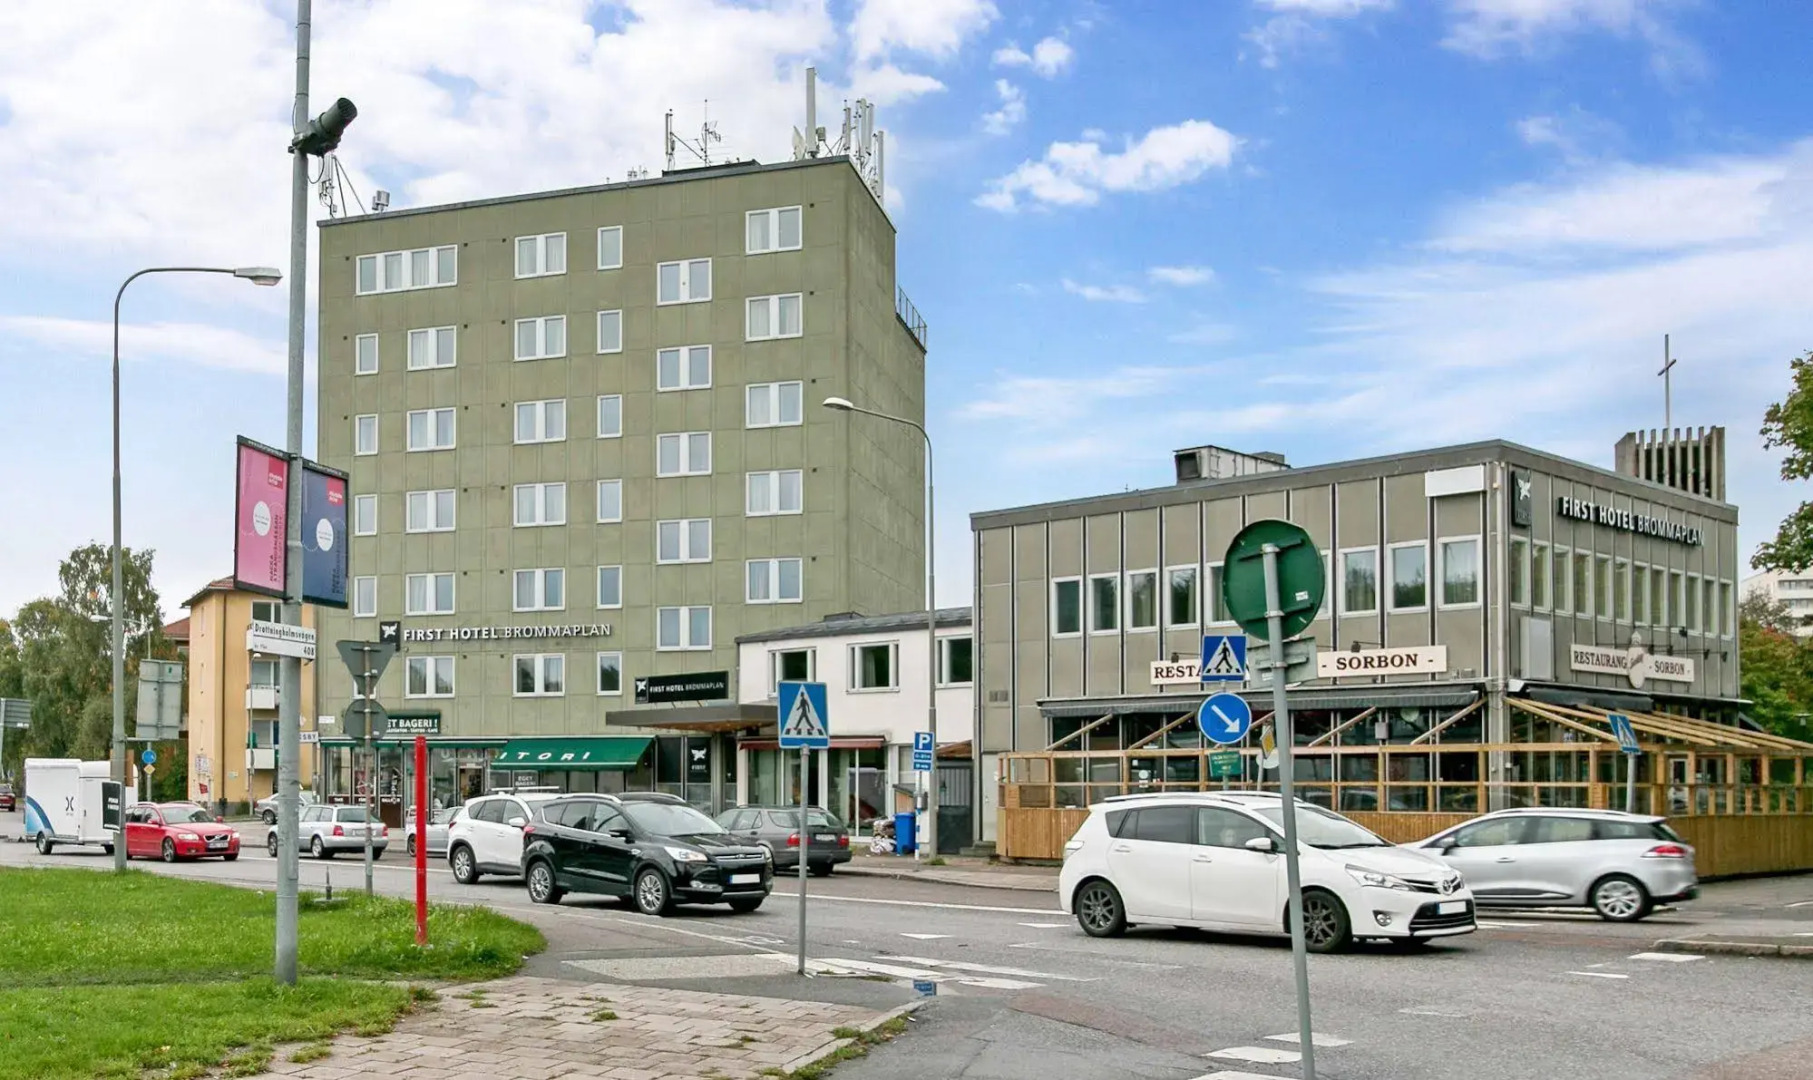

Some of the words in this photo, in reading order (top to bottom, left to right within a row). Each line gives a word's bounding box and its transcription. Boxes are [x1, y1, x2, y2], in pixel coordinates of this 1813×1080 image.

[1562, 496, 1596, 521] FIRST
[1599, 506, 1635, 531] HOTEL
[1637, 514, 1705, 546] BROMMAPLAN
[403, 627, 444, 641] FIRST
[450, 627, 499, 640] HOTEL
[505, 624, 611, 638] BROMMAPLAN
[1336, 653, 1418, 670] SORBON
[1573, 650, 1628, 669] RESTAURANG
[1654, 660, 1685, 675] SORBON
[649, 685, 665, 693] FIRST
[665, 684, 684, 692] HOTEL
[399, 719, 432, 728] BAGERI
